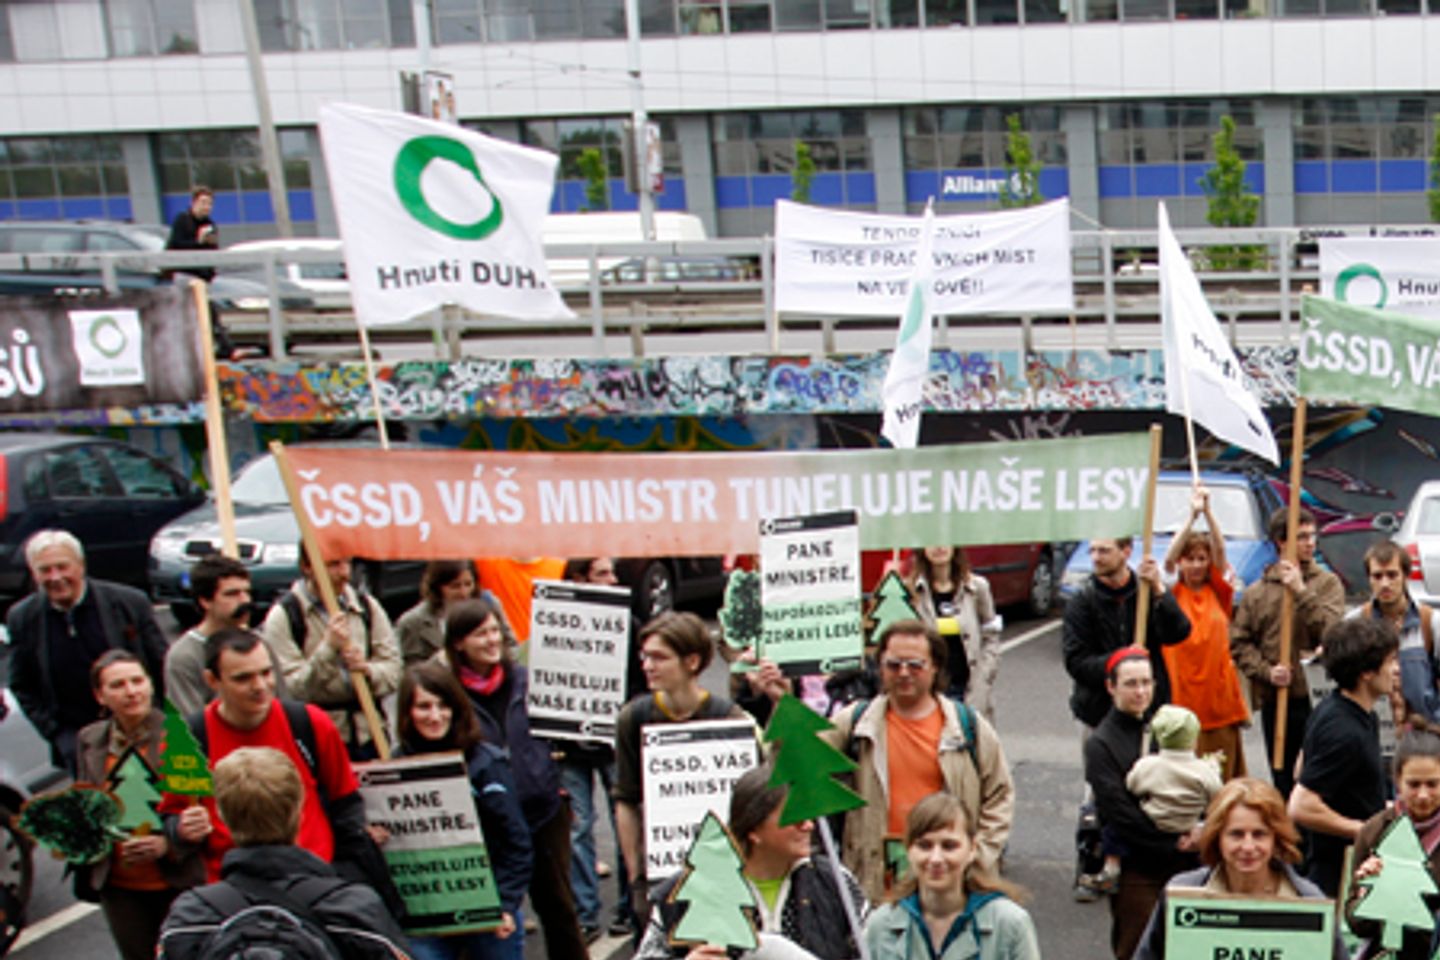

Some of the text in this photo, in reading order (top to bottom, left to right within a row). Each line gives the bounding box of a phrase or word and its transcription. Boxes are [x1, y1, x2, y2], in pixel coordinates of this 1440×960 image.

[1299, 317, 1401, 388] ČSSD,
[298, 456, 1150, 542] ČSSD, VÁŠ MINISTR TUNELUJE NAŠE LESY
[787, 541, 834, 560] PANE
[542, 635, 615, 655] MINISTR
[534, 669, 621, 691] TUNELUJE
[388, 791, 442, 811] PANE
[445, 876, 487, 891] LESY
